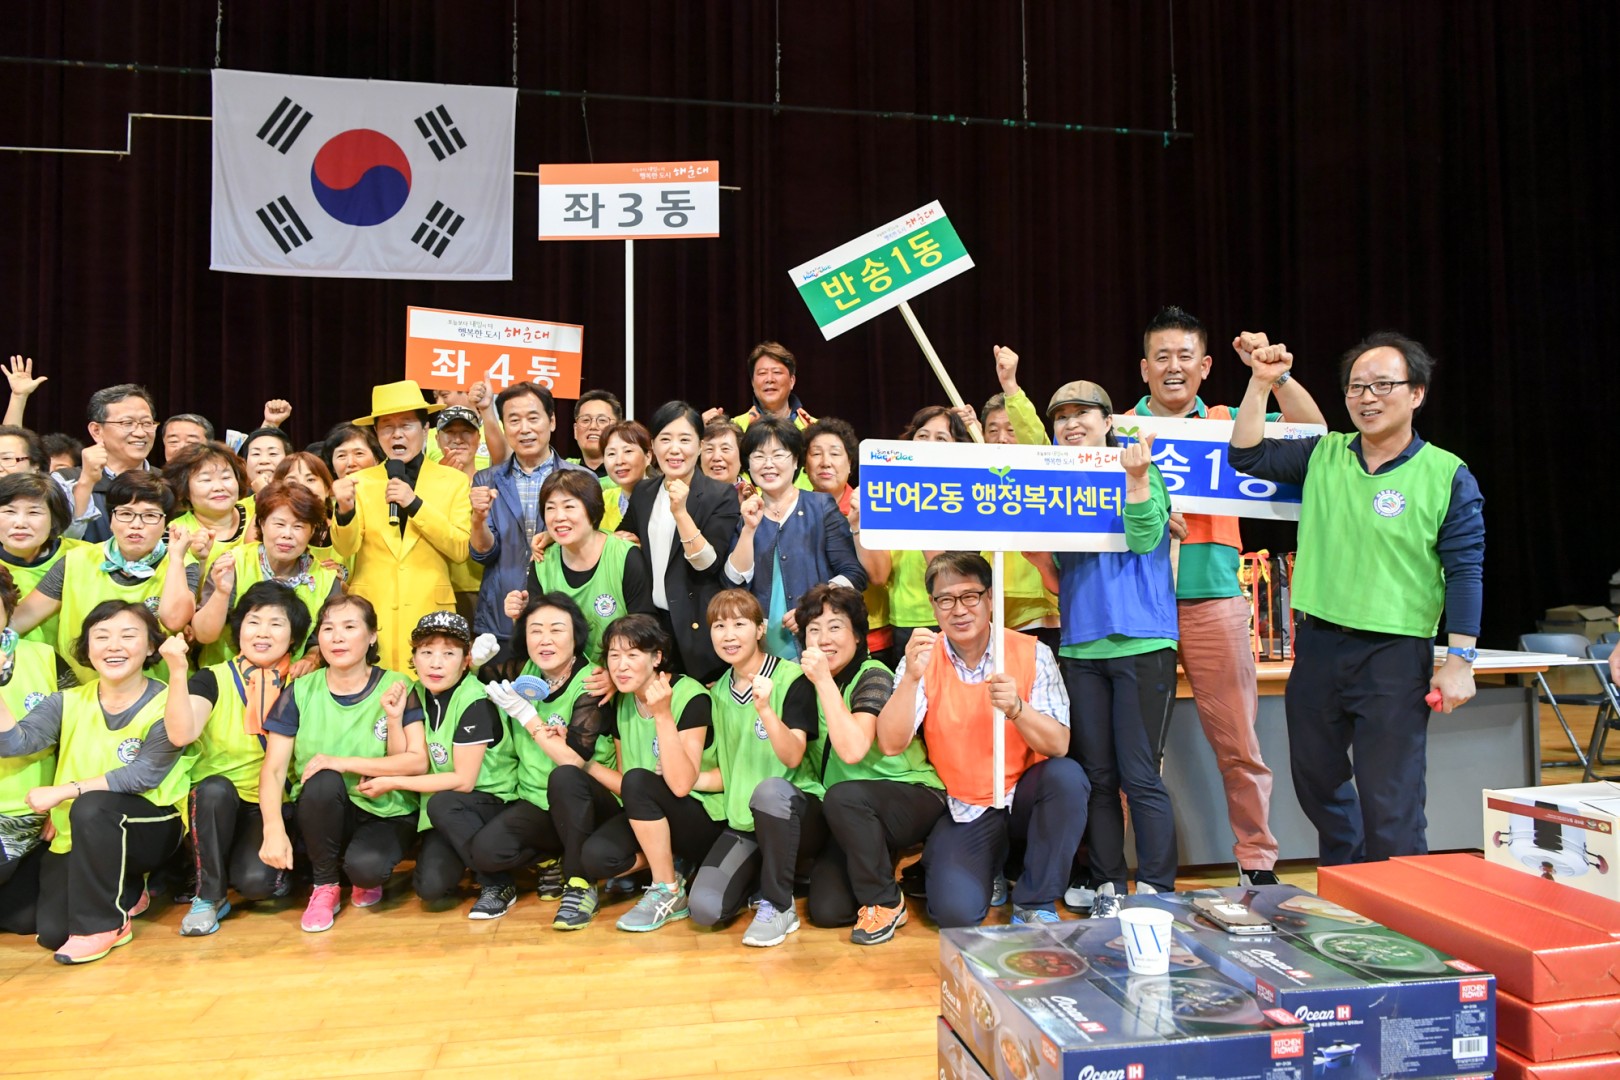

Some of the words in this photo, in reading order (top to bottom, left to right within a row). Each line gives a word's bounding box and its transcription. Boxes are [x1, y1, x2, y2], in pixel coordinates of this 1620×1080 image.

[673, 165, 710, 179] 해운대
[820, 230, 943, 312] 반송1동
[504, 326, 550, 343] 해운대
[1078, 451, 1118, 468] 해운대
[867, 480, 965, 514] 반여2동
[971, 482, 1122, 517] 행정복지센터
[1294, 1005, 1335, 1021] Ocean
[1337, 1007, 1350, 1019] IH
[1274, 1038, 1301, 1047] KITCHEN
[1274, 1046, 1300, 1055] FLOWER
[1078, 1065, 1126, 1080] Ocean
[1129, 1067, 1142, 1079] IH
